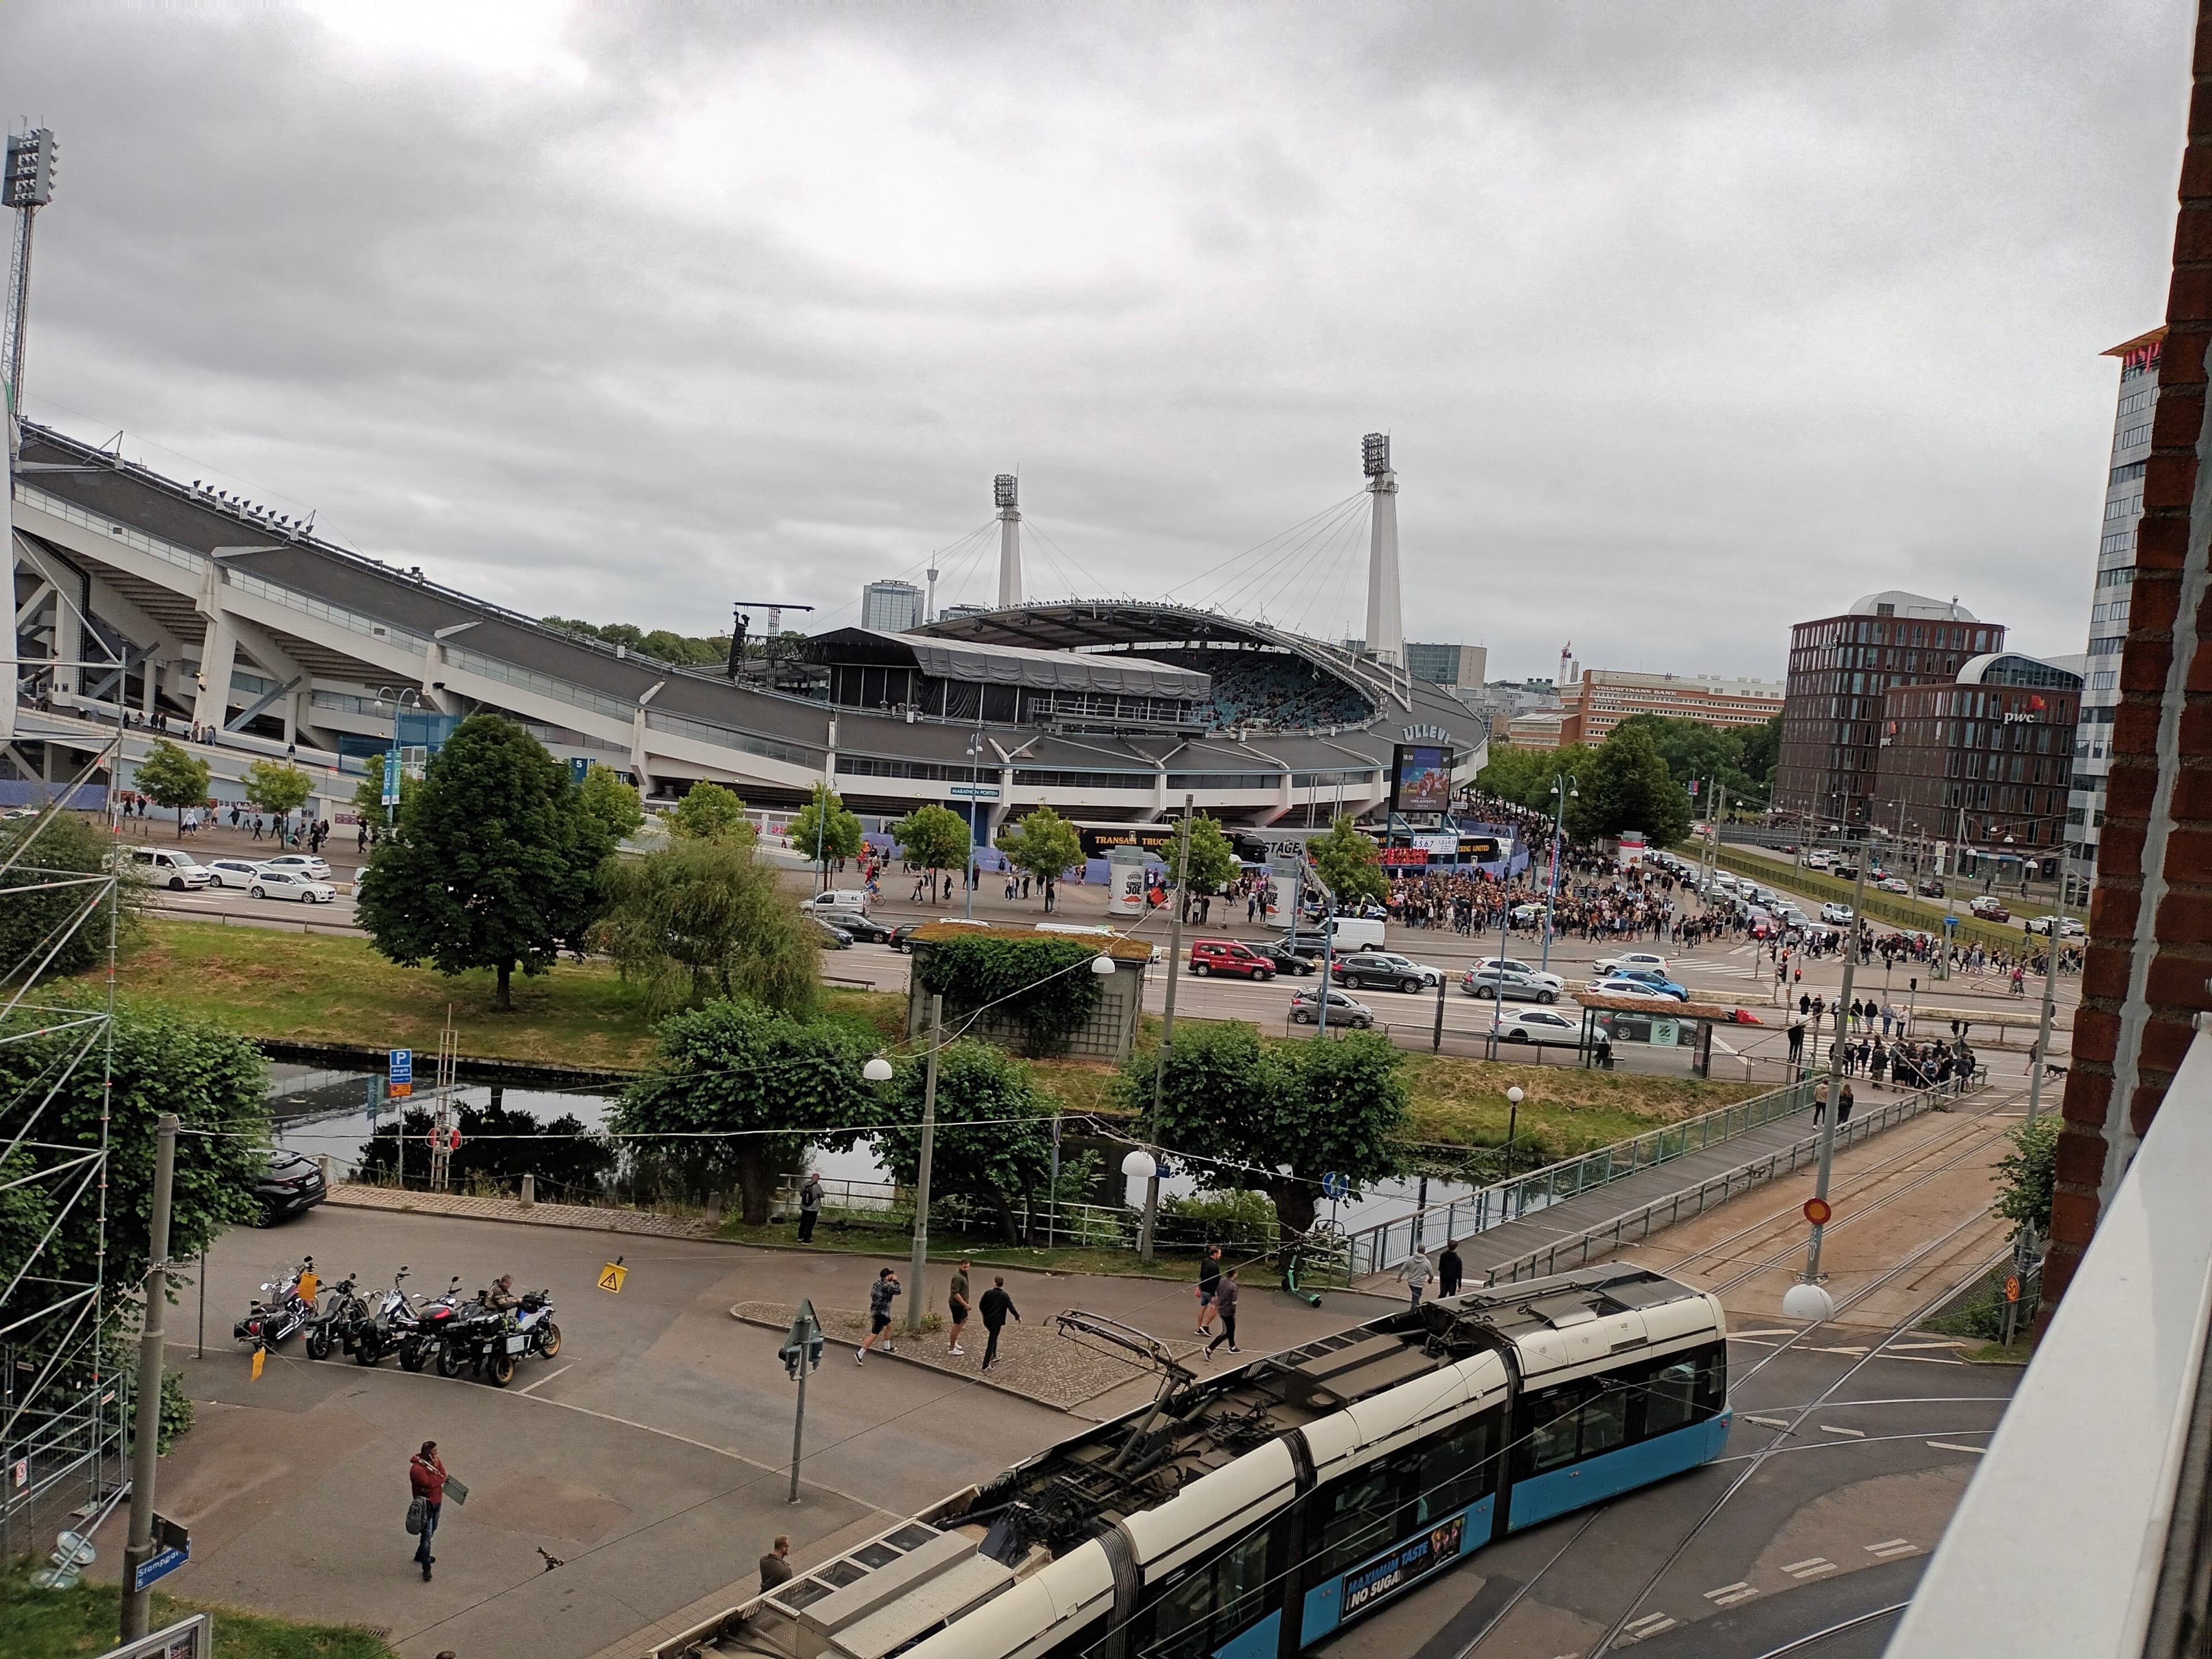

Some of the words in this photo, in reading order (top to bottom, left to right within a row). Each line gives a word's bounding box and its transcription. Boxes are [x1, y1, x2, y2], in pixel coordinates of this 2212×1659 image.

[2003, 712, 2035, 725] pwc
[1402, 724, 1450, 745] ULLEVI
[576, 760, 582, 768] 5
[1263, 842, 1300, 854] STAGE
[1126, 886, 1141, 895] JOE
[396, 1051, 407, 1065] P
[2008, 1282, 2016, 1297] 50
[1401, 1540, 1429, 1567] TASTE
[1350, 1587, 1369, 1609] NO
